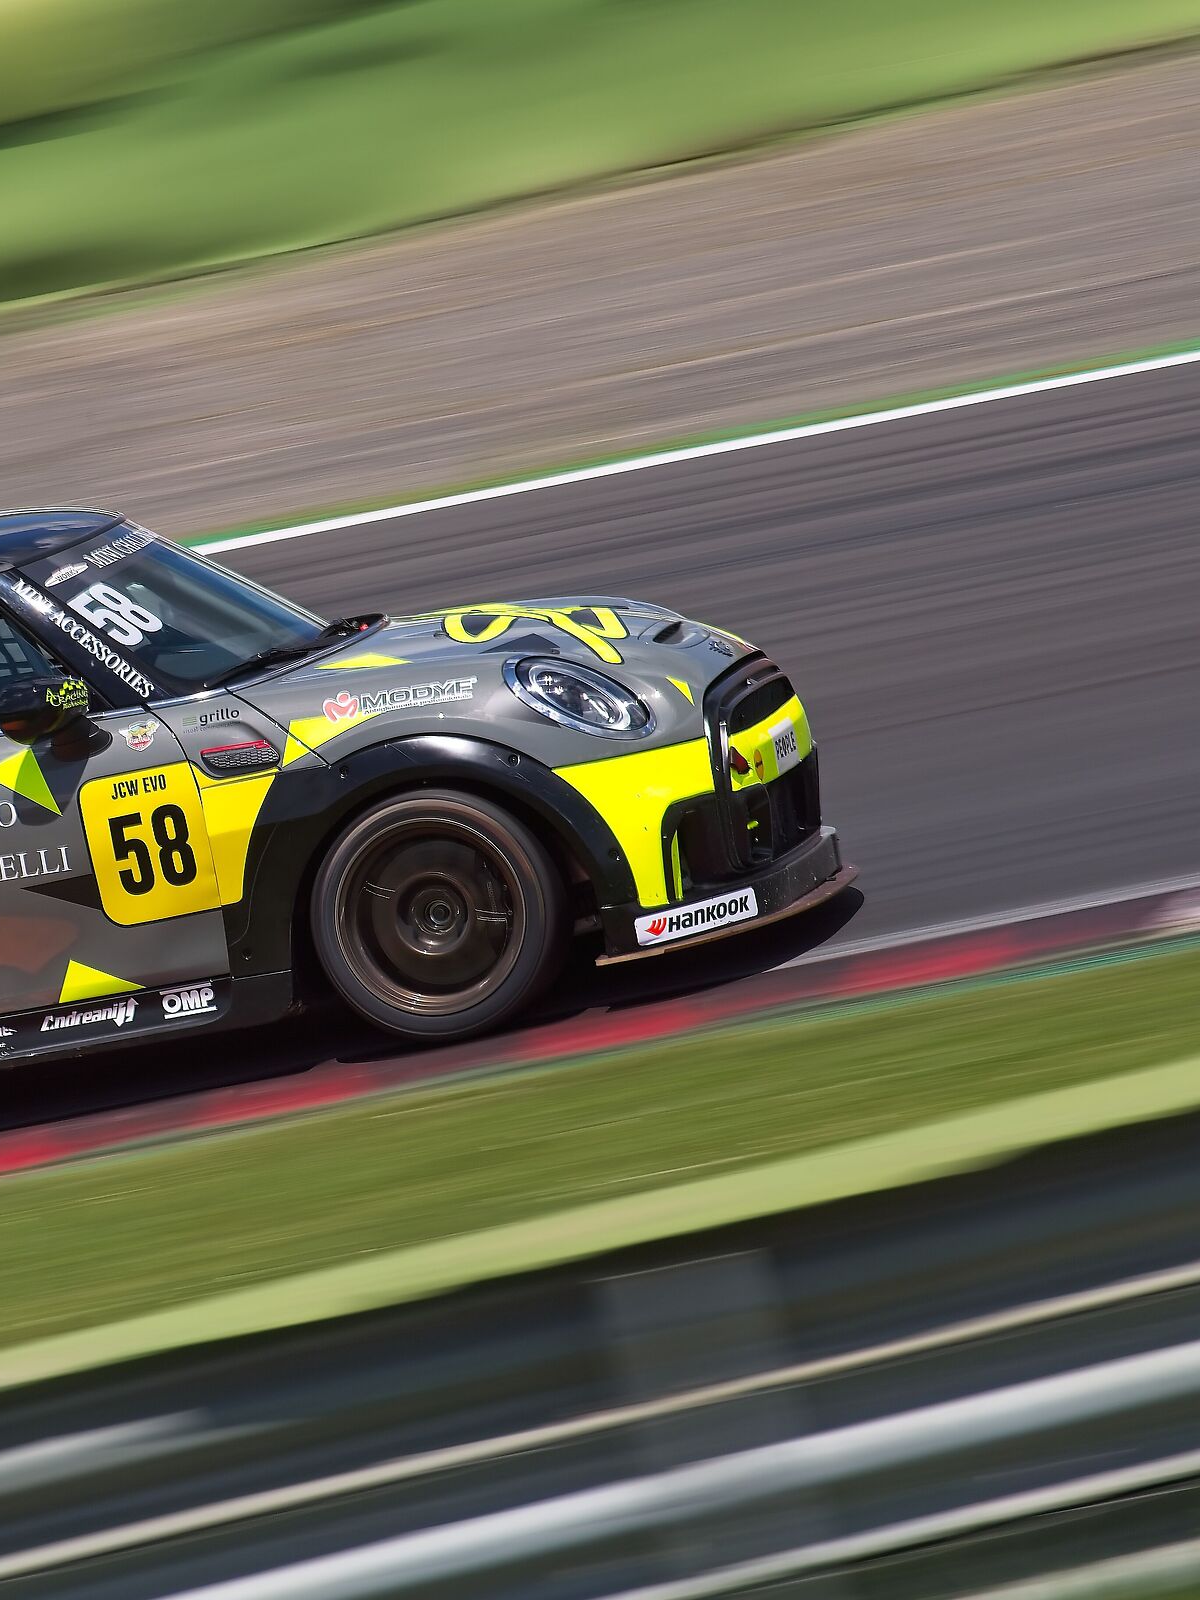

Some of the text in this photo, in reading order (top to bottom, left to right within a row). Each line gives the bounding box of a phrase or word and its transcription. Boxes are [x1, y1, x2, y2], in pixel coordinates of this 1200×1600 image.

[67, 582, 163, 646] 58
[50, 609, 155, 698] ACCESSORIES
[200, 708, 240, 727] grillo
[775, 731, 797, 761] PEOPLE
[111, 774, 167, 800] JCW EVO
[108, 804, 198, 896] 58
[162, 986, 215, 1015] OMP
